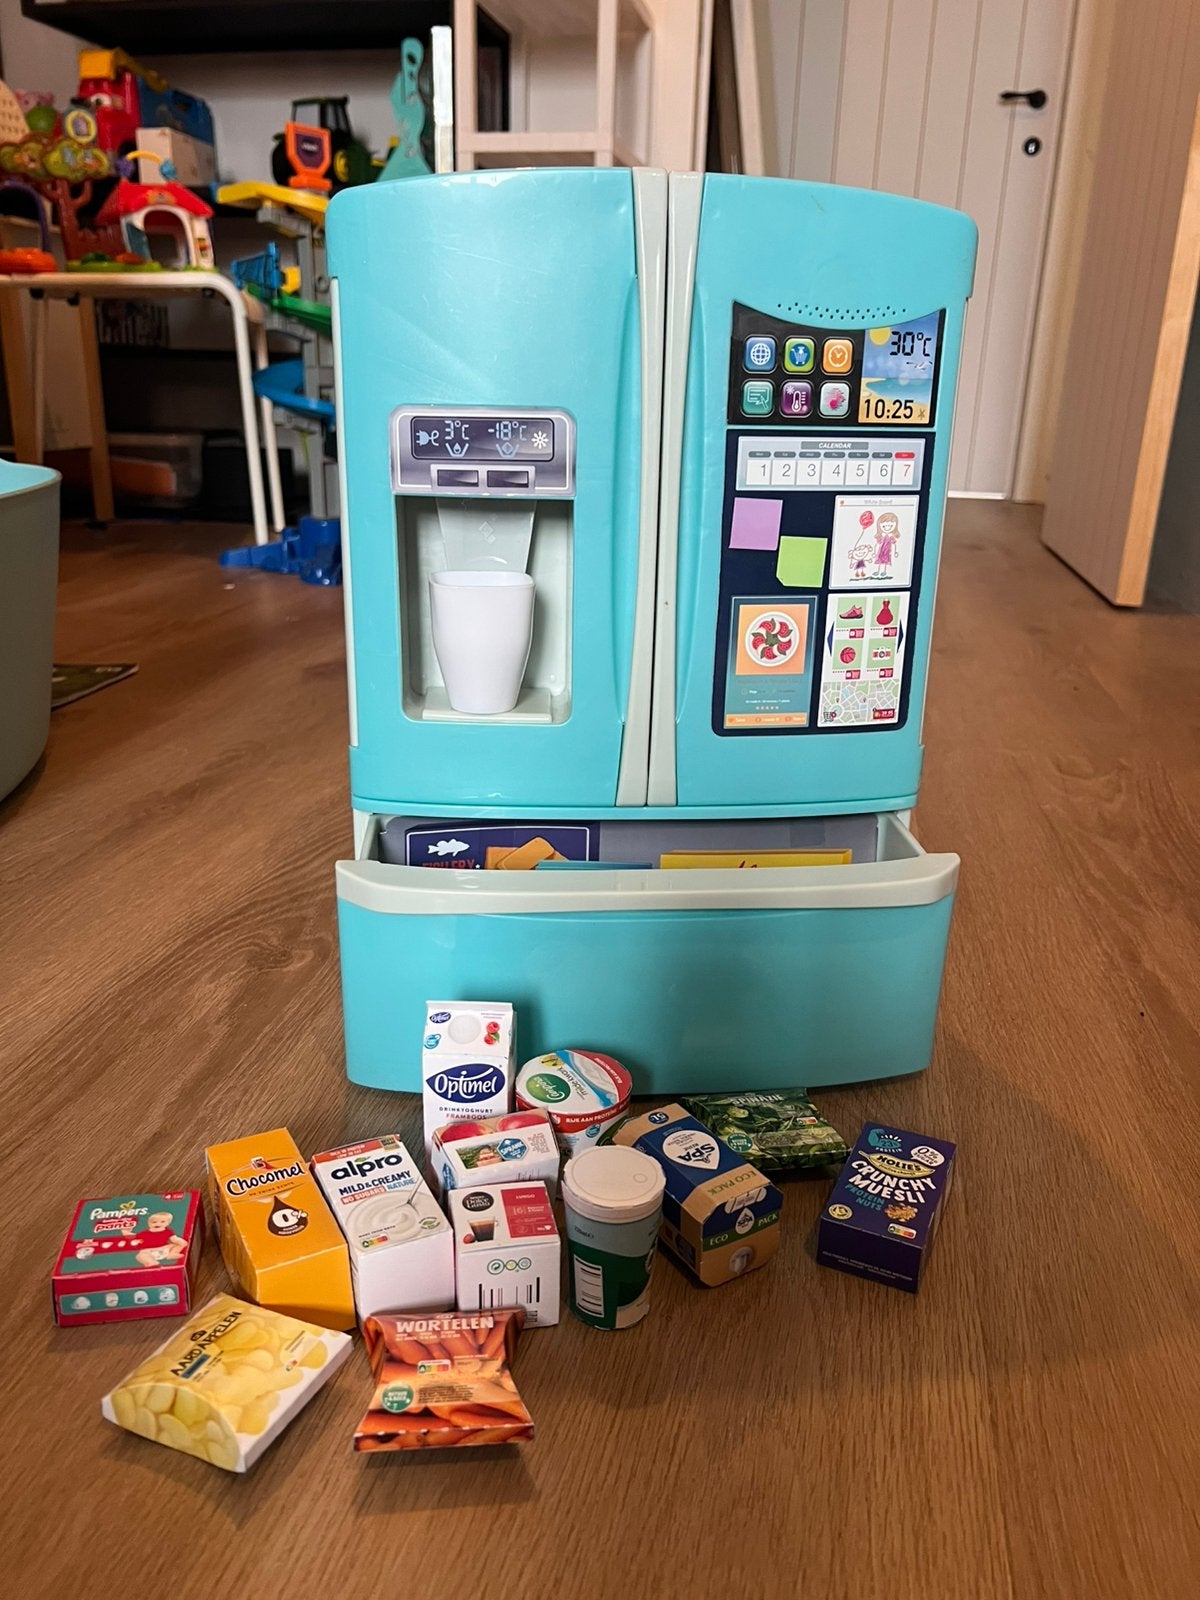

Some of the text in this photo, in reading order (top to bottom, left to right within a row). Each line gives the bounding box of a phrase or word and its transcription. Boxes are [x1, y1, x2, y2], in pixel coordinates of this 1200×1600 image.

[864, 398, 914, 420] 10:25
[818, 442, 852, 450] CALENDAR
[760, 463, 911, 477] 1 2 3 4 5 6 7
[434, 1067, 498, 1099] Optimel
[439, 1106, 493, 1114] DRINKYOGHURT
[446, 1113, 487, 1121] FRAMBOOS
[677, 1143, 715, 1162] SPA
[331, 1154, 403, 1180] alpro
[851, 1160, 937, 1191] CRUNCHY
[226, 1162, 306, 1195] Chocomel
[708, 1171, 757, 1195] ECO PACK
[848, 1173, 926, 1204] MUESLI
[342, 1178, 417, 1203] NO SUGARS NATURE
[844, 1184, 885, 1205] PROTEIN
[90, 1207, 149, 1220] Pampers
[855, 1197, 882, 1212] NUTS
[94, 1221, 136, 1233] pants
[272, 1208, 308, 1228] 0%
[709, 1214, 777, 1246] ECO PACK
[396, 1316, 494, 1333] WORTELEN
